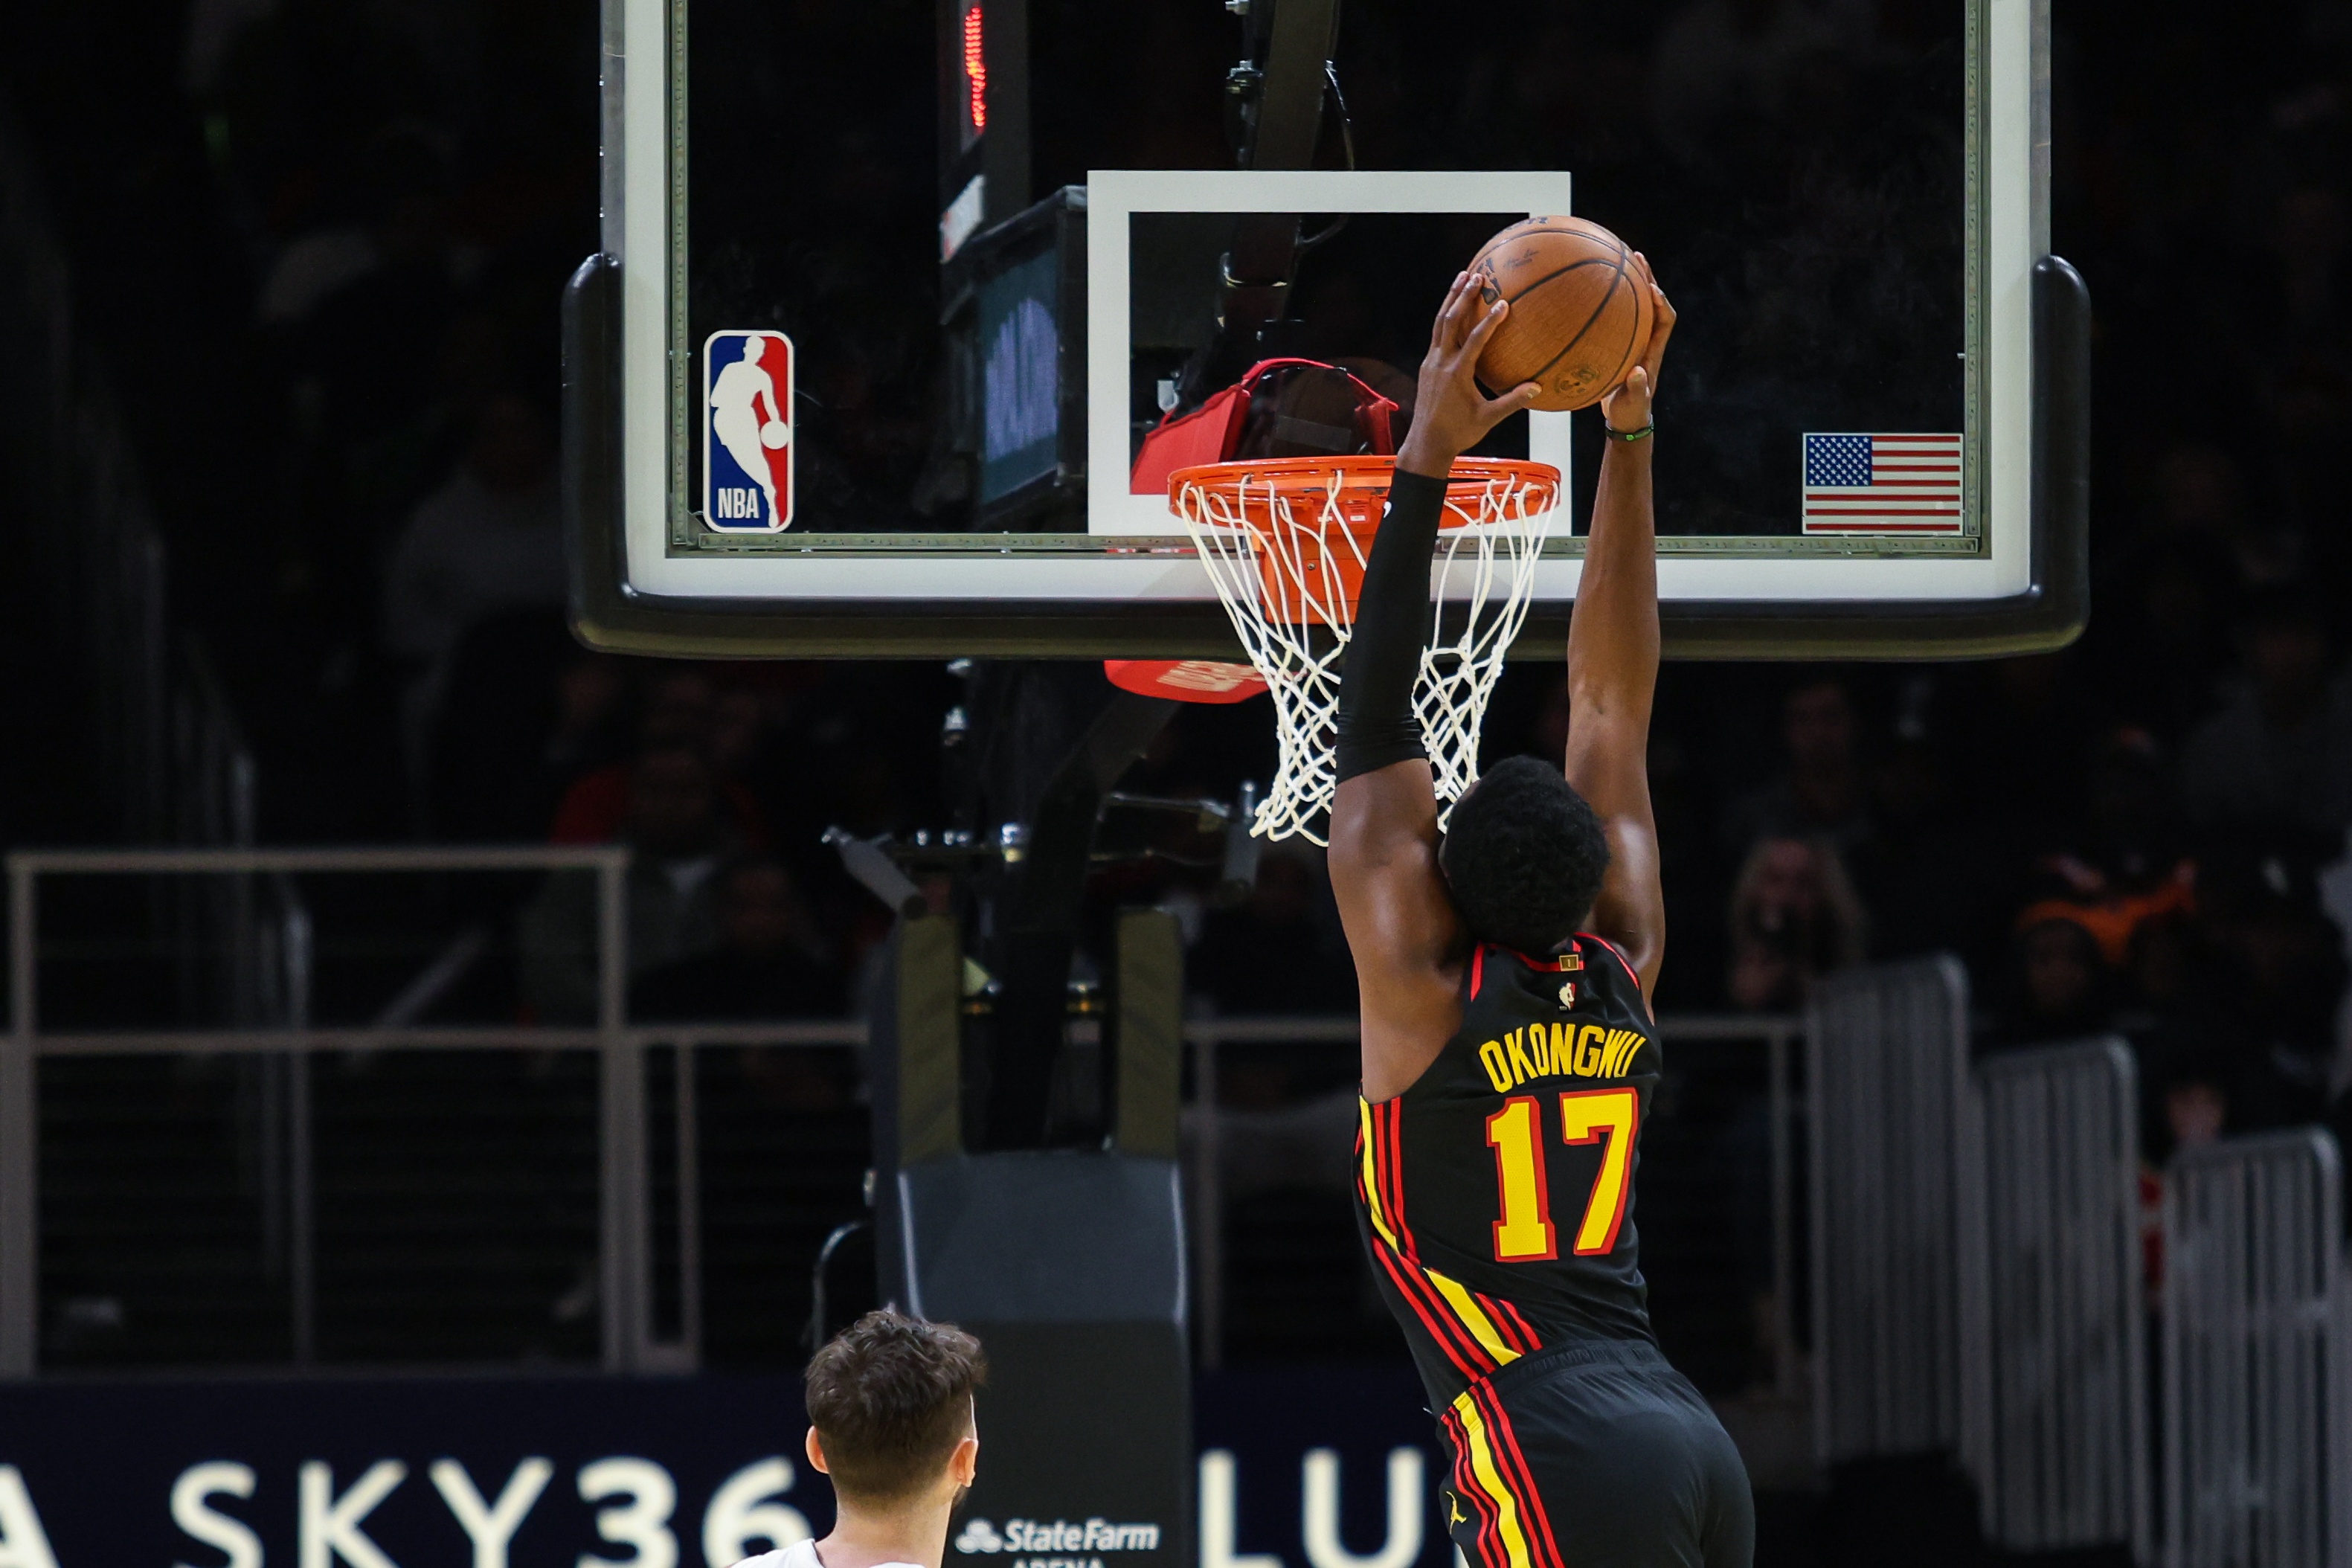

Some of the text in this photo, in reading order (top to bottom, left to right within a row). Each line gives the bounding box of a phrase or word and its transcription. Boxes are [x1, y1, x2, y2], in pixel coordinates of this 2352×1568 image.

[718, 488, 759, 518] NBA
[1479, 1022, 1646, 1093] OKONGWU
[1486, 1087, 1638, 1262] 17
[1199, 1446, 1468, 1568] LU
